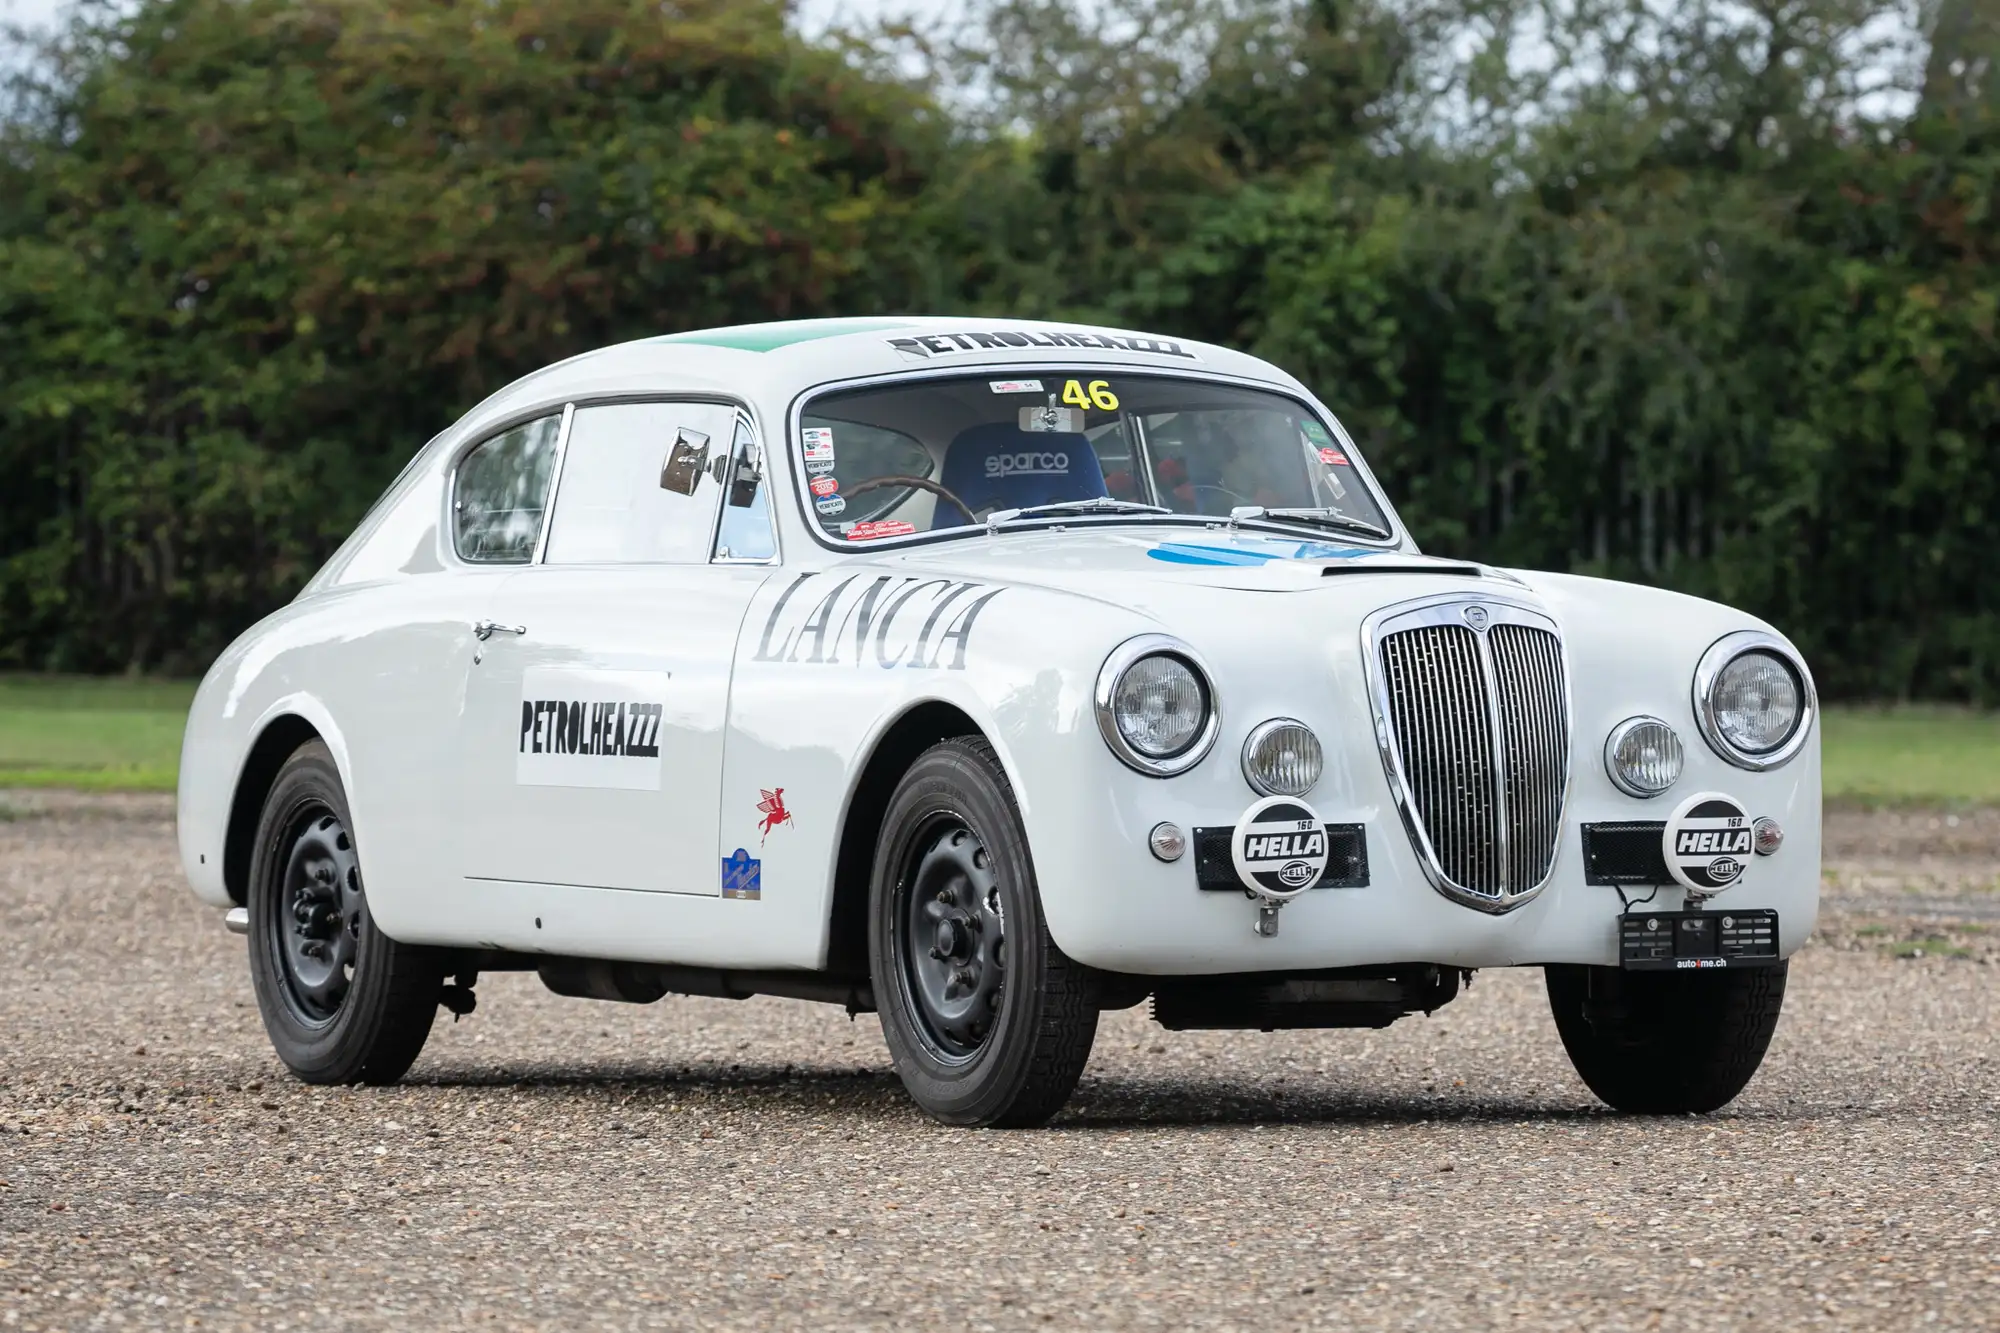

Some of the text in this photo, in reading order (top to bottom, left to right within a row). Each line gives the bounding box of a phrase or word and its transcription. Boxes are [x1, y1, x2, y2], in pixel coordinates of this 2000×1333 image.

[1062, 379, 1120, 411] 46
[985, 452, 1069, 478] sparco
[751, 572, 1009, 670] LANCIA
[520, 700, 663, 757] PETROLHEAZZZ
[1297, 820, 1313, 830] 160
[1727, 818, 1743, 828] 160
[1246, 833, 1322, 858] HELLA
[1677, 831, 1751, 853] HELLA
[1282, 866, 1312, 877] HELLA
[1710, 862, 1739, 873] HELLA
[1677, 958, 1727, 968] auto4me.ch
